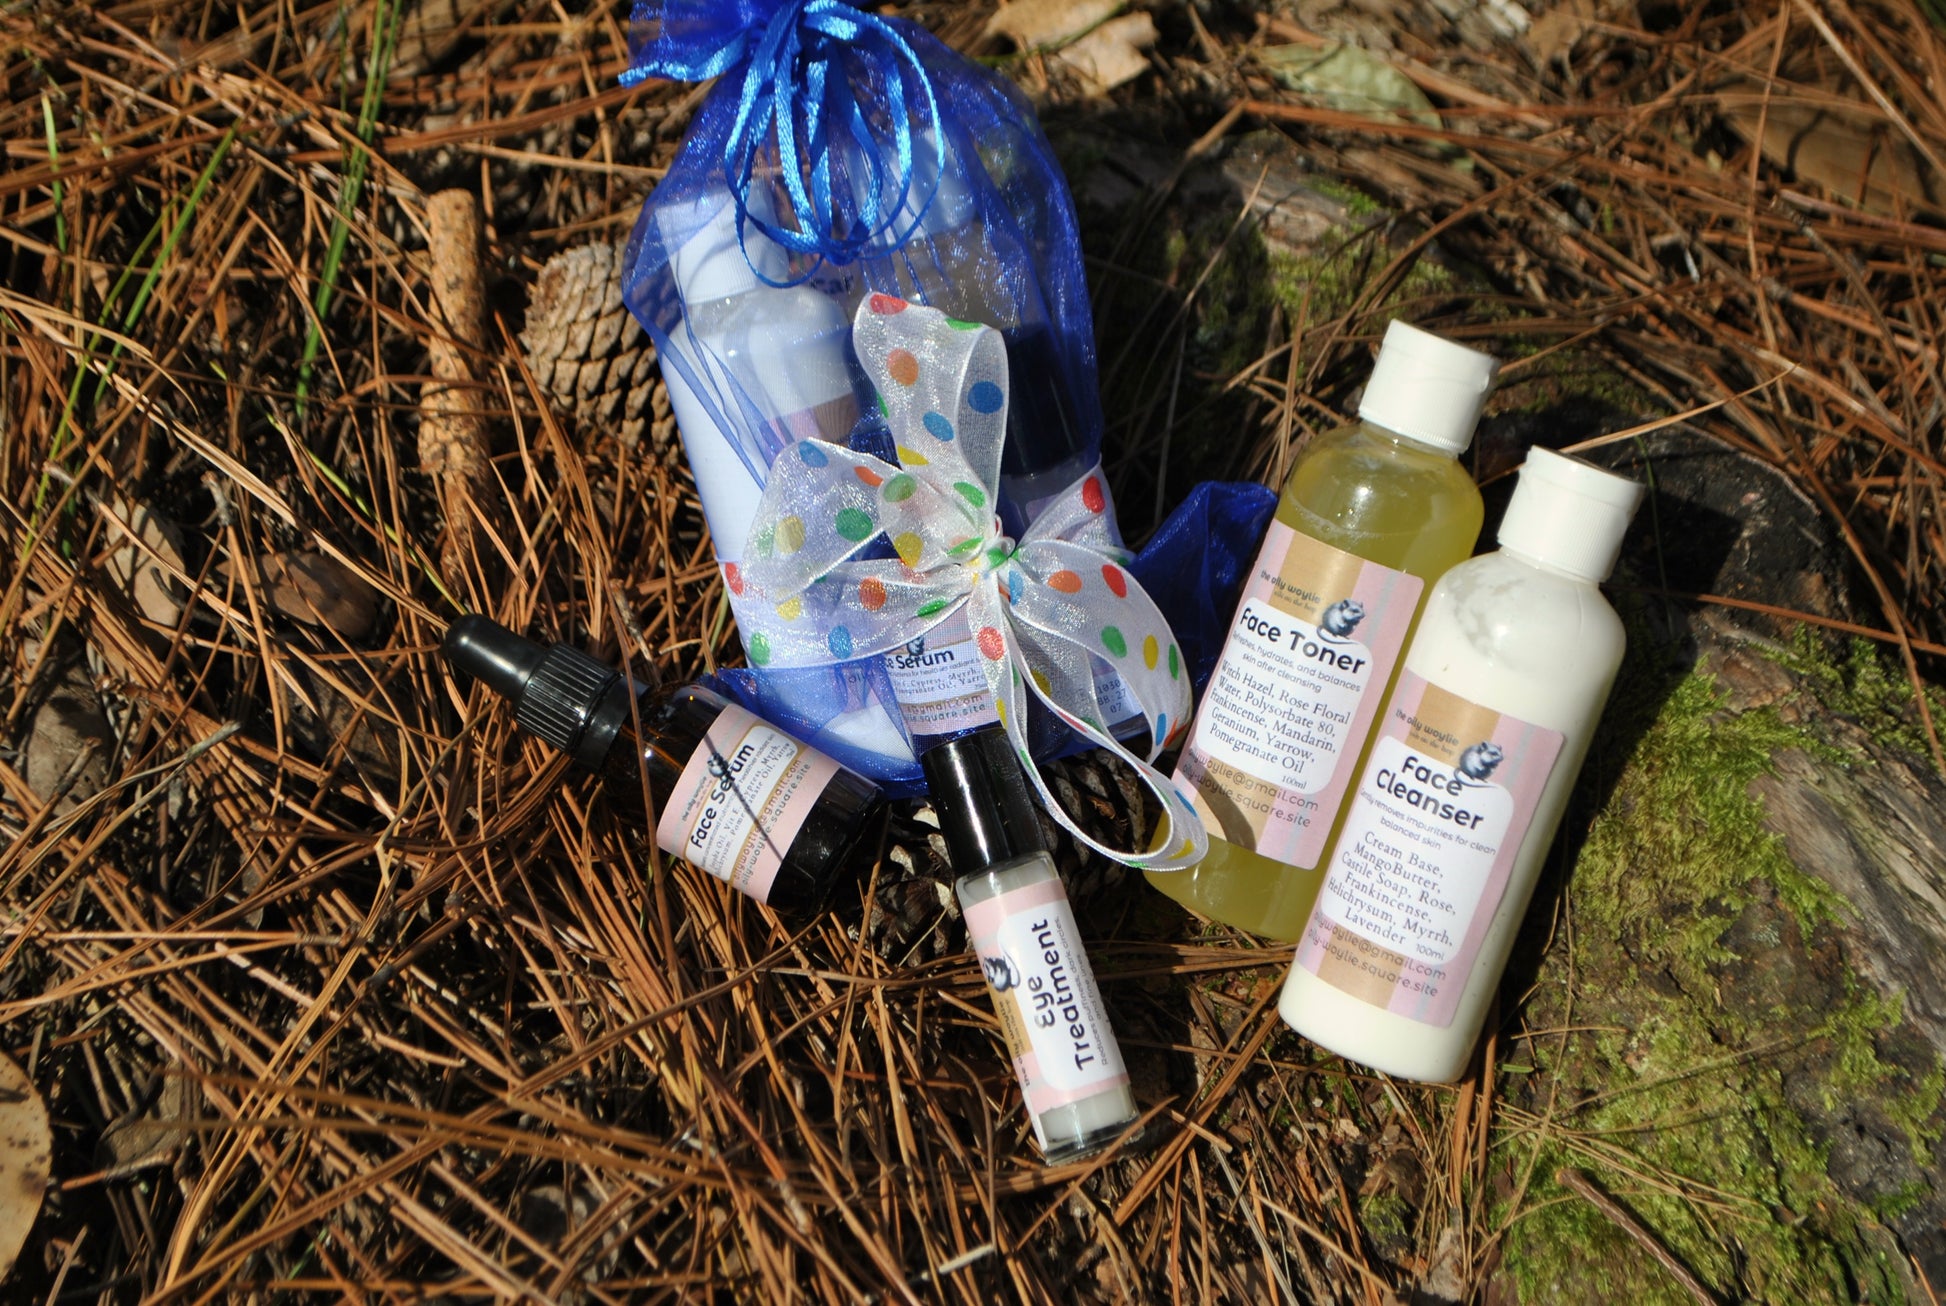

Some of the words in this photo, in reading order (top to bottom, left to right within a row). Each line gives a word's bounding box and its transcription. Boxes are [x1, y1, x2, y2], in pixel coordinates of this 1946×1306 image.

[1260, 569, 1270, 581] the
[1270, 574, 1286, 590] oily
[1286, 583, 1322, 605] woylie
[895, 648, 954, 669] Serum
[1238, 606, 1283, 643] Face
[1283, 628, 1366, 677] Toner
[1220, 659, 1242, 681] Witch
[1241, 671, 1278, 698] Hazel,
[1278, 689, 1310, 711] Rose
[1312, 699, 1351, 725] Floral
[1241, 652, 1256, 665] skin
[1255, 659, 1276, 674] after
[1276, 667, 1322, 693] cleansing
[1255, 645, 1297, 669] hydrates,
[1296, 661, 1317, 677] and
[1316, 669, 1361, 693] balances
[1209, 687, 1270, 728] Frankincense,
[1271, 719, 1338, 754] Mandarin,
[1216, 675, 1244, 699] Water,
[1243, 690, 1315, 730] Polysorbate
[1316, 720, 1338, 738] 80,
[1395, 708, 1406, 720] the
[1406, 715, 1423, 731] oily
[1422, 725, 1460, 748] woylie
[1208, 722, 1279, 765] Pomegranate
[1280, 754, 1305, 773] Oil
[1209, 705, 1262, 741] Geranium,
[1264, 732, 1317, 763] Yarrow,
[688, 805, 718, 848] Face
[708, 741, 755, 805] Serum
[1281, 773, 1307, 790] 100ml
[1373, 767, 1484, 832] Cleanser
[1400, 754, 1465, 798] Face
[728, 780, 764, 836] Pomeanate
[739, 761, 811, 885] oily-woyle.square.site
[1373, 799, 1406, 821] removes
[1405, 813, 1454, 841] impurities
[1454, 833, 1469, 846] for
[1469, 839, 1496, 856] clean
[1379, 815, 1421, 841] balanced
[1420, 835, 1442, 850] skin
[1363, 830, 1404, 860] Cream
[1407, 852, 1446, 879] Base,
[1340, 851, 1374, 879] Castile
[1375, 872, 1414, 901] Soap,
[1417, 890, 1458, 916] Rose,
[1344, 871, 1434, 923] Frankincense,
[1052, 915, 1069, 949] circles,
[1327, 876, 1399, 925] Helichrysum,
[1402, 917, 1456, 947] Myrrh,
[1344, 906, 1407, 945] Lavender
[1415, 943, 1445, 962] 100ml
[1064, 950, 1077, 973] dark
[1025, 972, 1057, 1030] Eye
[1028, 918, 1096, 1071] Treatment
[1073, 974, 1094, 1021] puffiness,
[1090, 1000, 1101, 1020] and
[998, 1000, 1015, 1040] woylie
[1089, 1022, 1108, 1065] Reduces
[1012, 1043, 1023, 1064] oily
[1020, 1067, 1030, 1086] the
